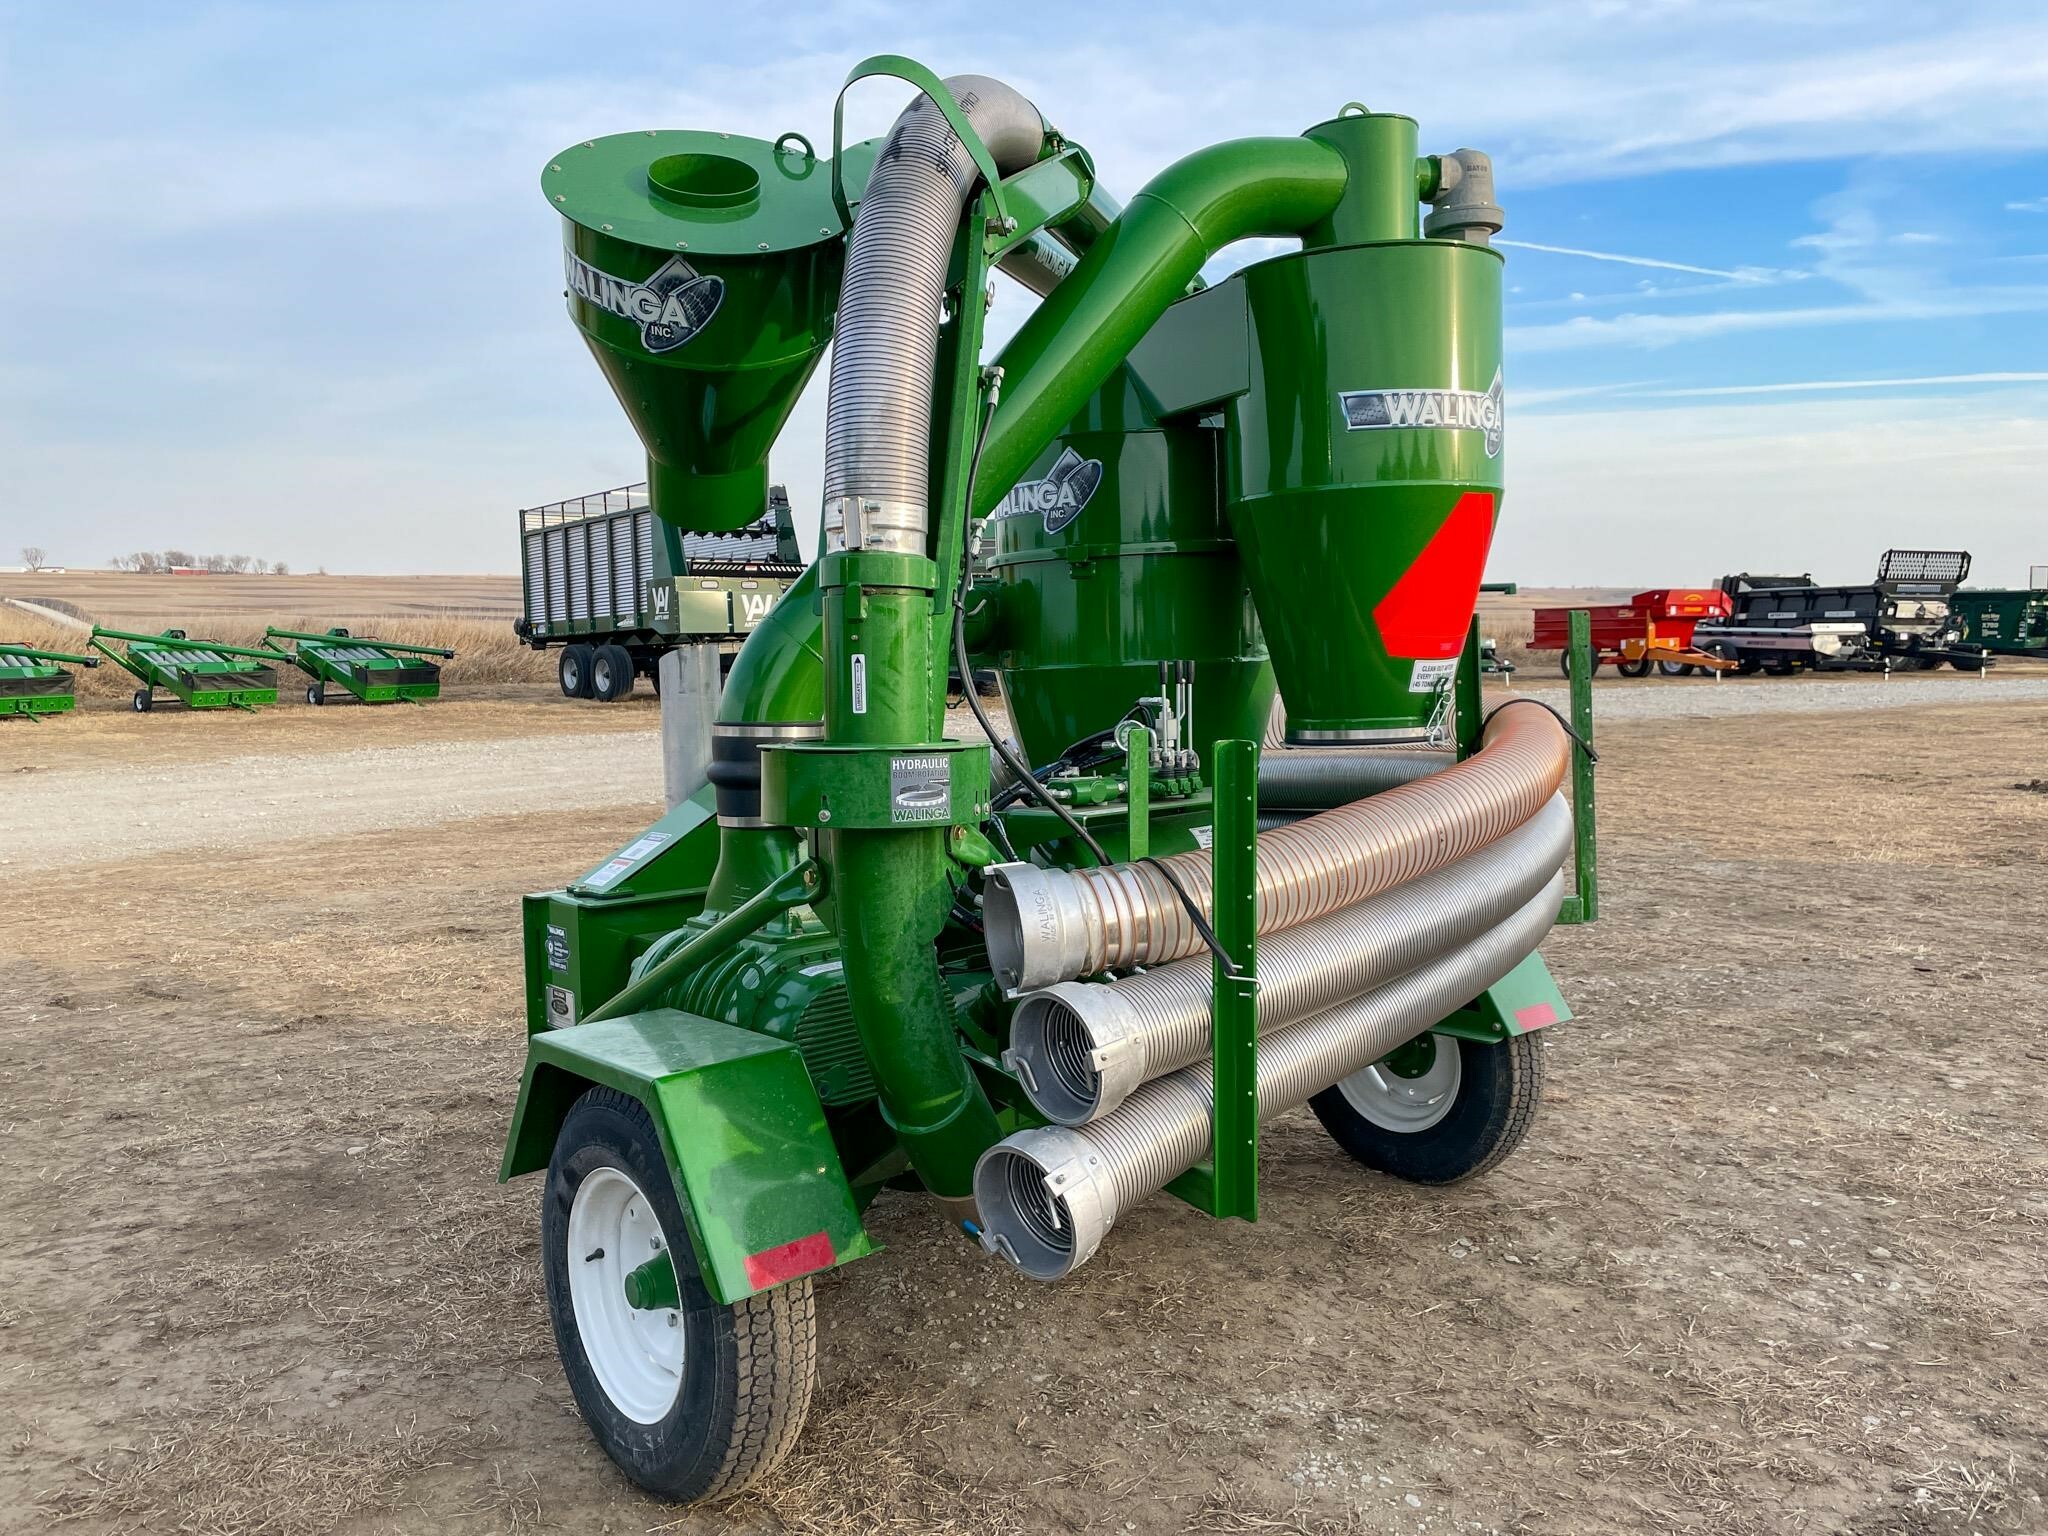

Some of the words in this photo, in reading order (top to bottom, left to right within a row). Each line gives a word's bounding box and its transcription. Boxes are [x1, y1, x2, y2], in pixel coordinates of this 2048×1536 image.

[565, 251, 690, 328] WALINGA
[651, 325, 674, 338] INC.
[1050, 509, 1067, 518] INC.
[892, 758, 948, 770] HYDRAULIC
[893, 807, 949, 821] WALINGA
[1033, 888, 1052, 943] WALINGA
